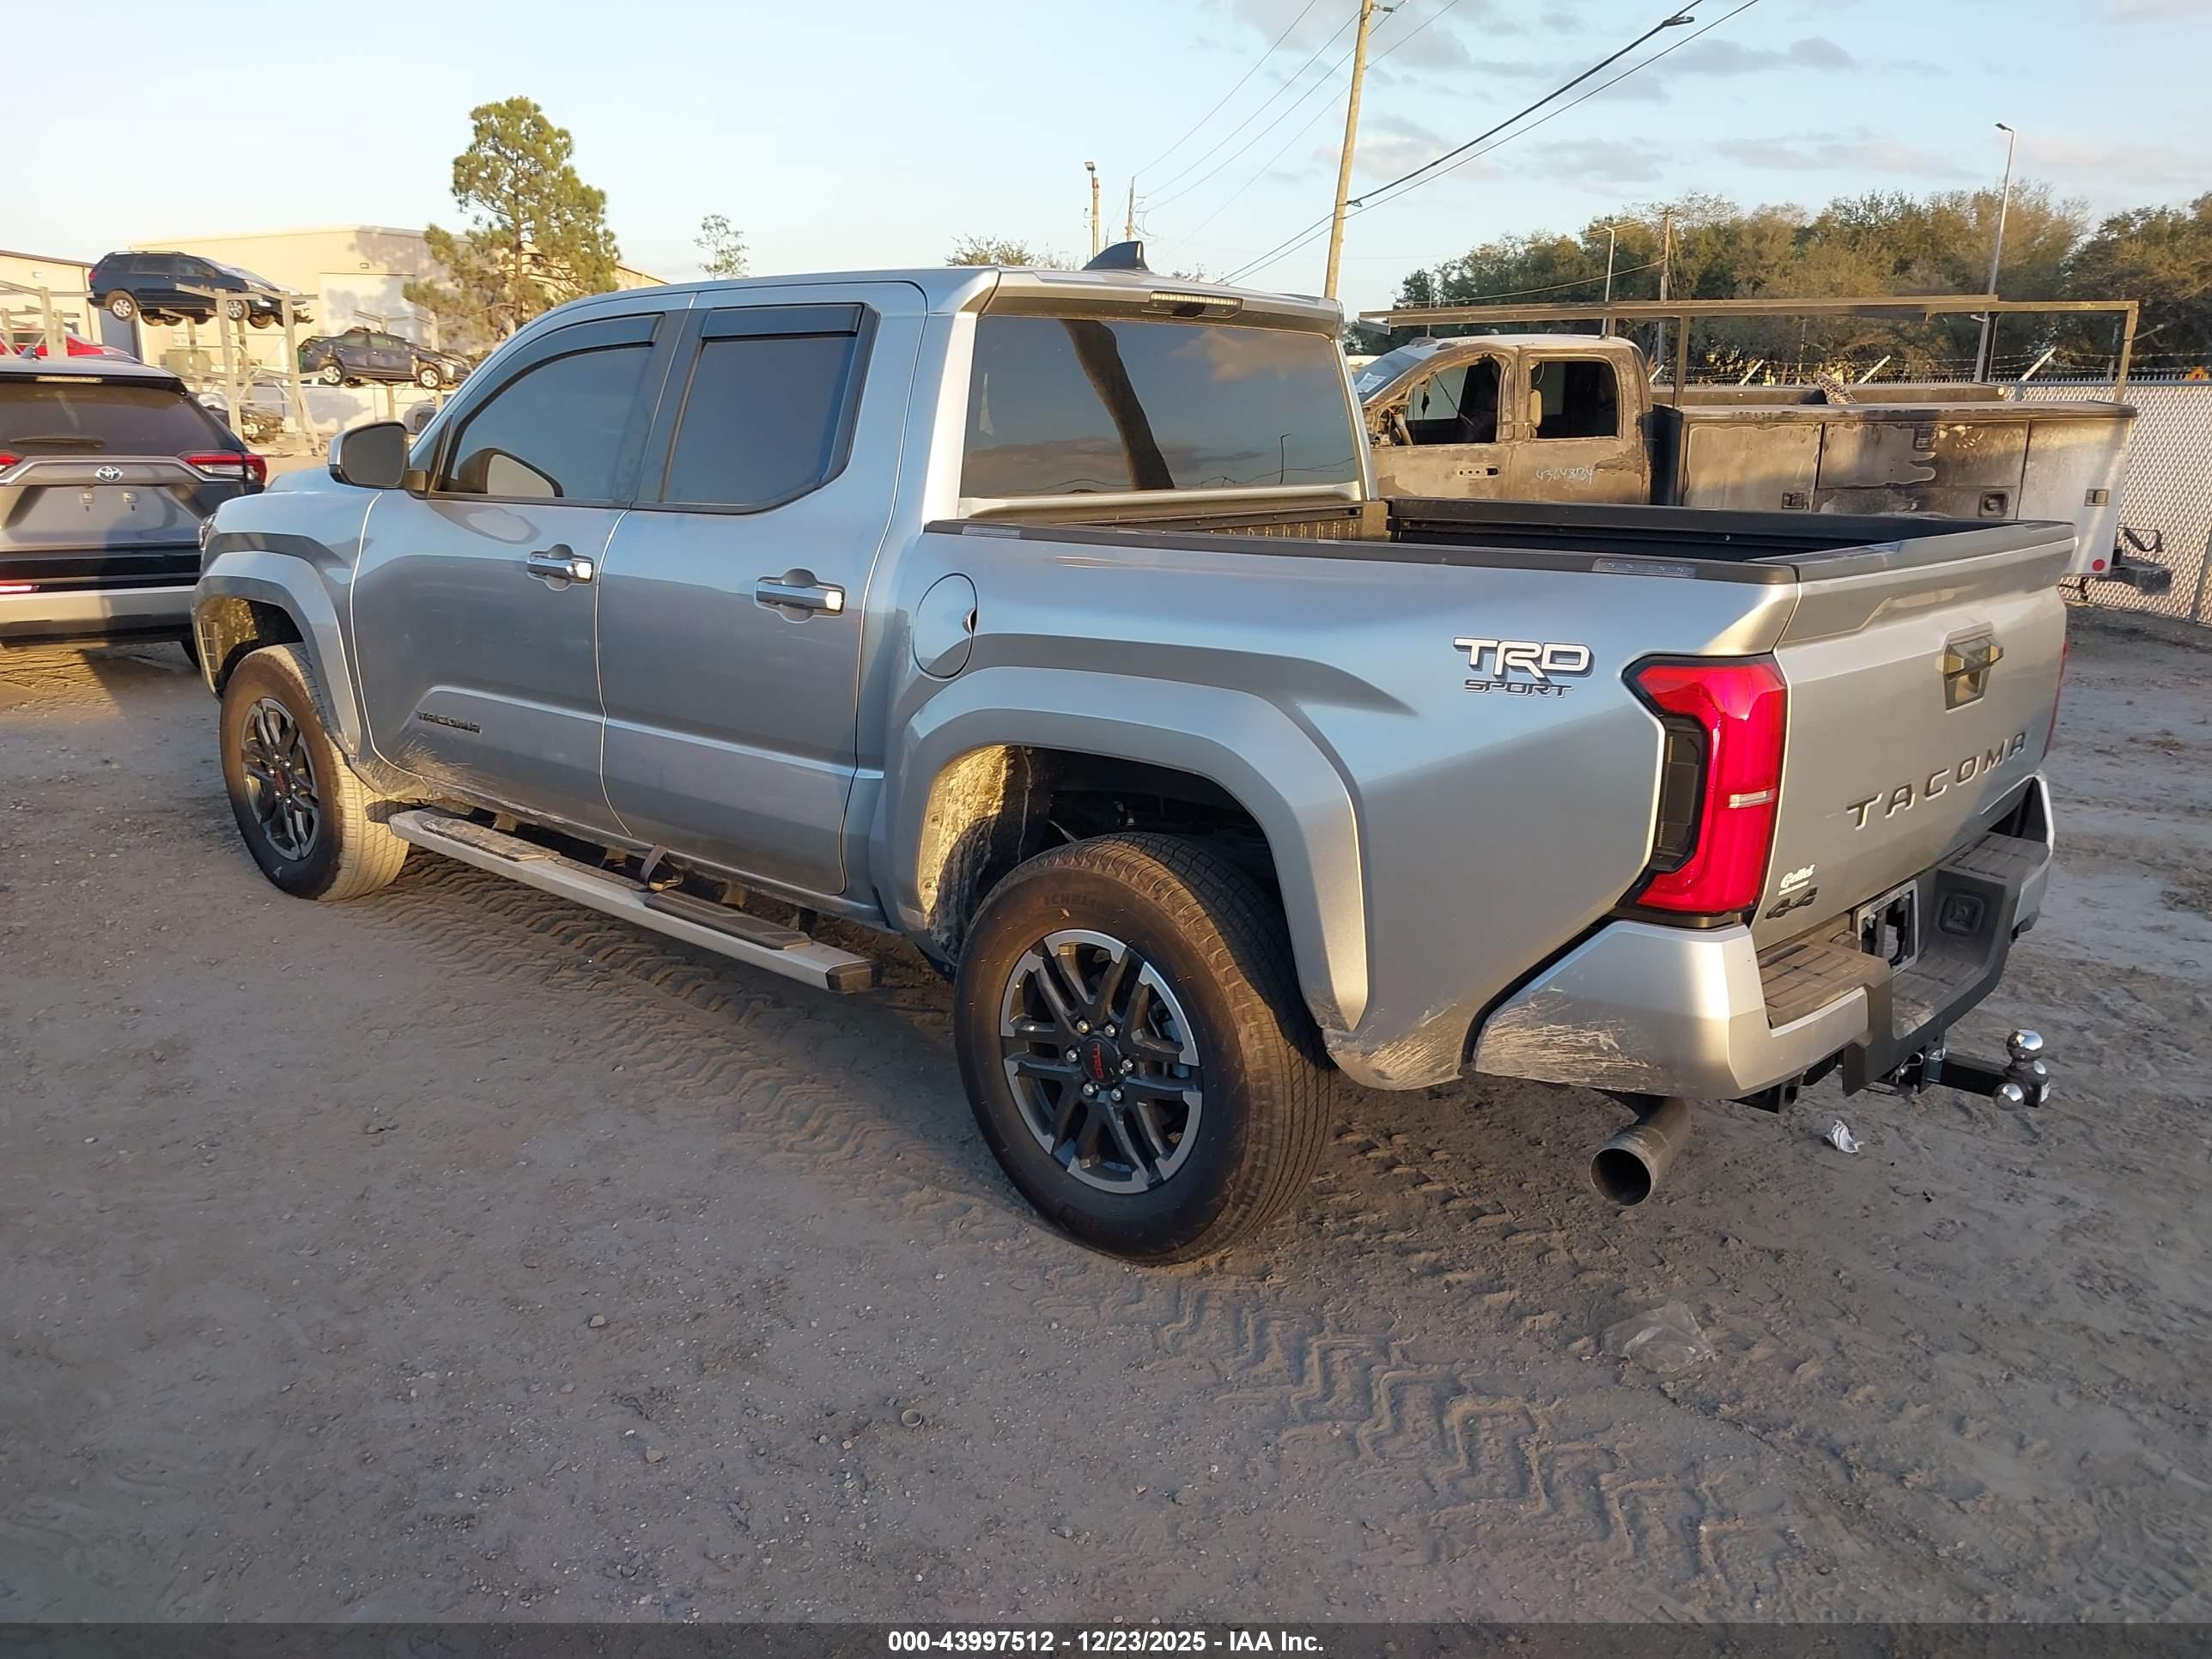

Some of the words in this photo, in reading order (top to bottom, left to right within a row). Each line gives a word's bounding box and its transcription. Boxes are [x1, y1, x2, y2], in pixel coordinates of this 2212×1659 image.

[1453, 637, 1595, 684] TRD
[1464, 679, 1573, 698] SPORT
[416, 710, 482, 733] TACOMA
[1846, 732, 2027, 830] TACOMA
